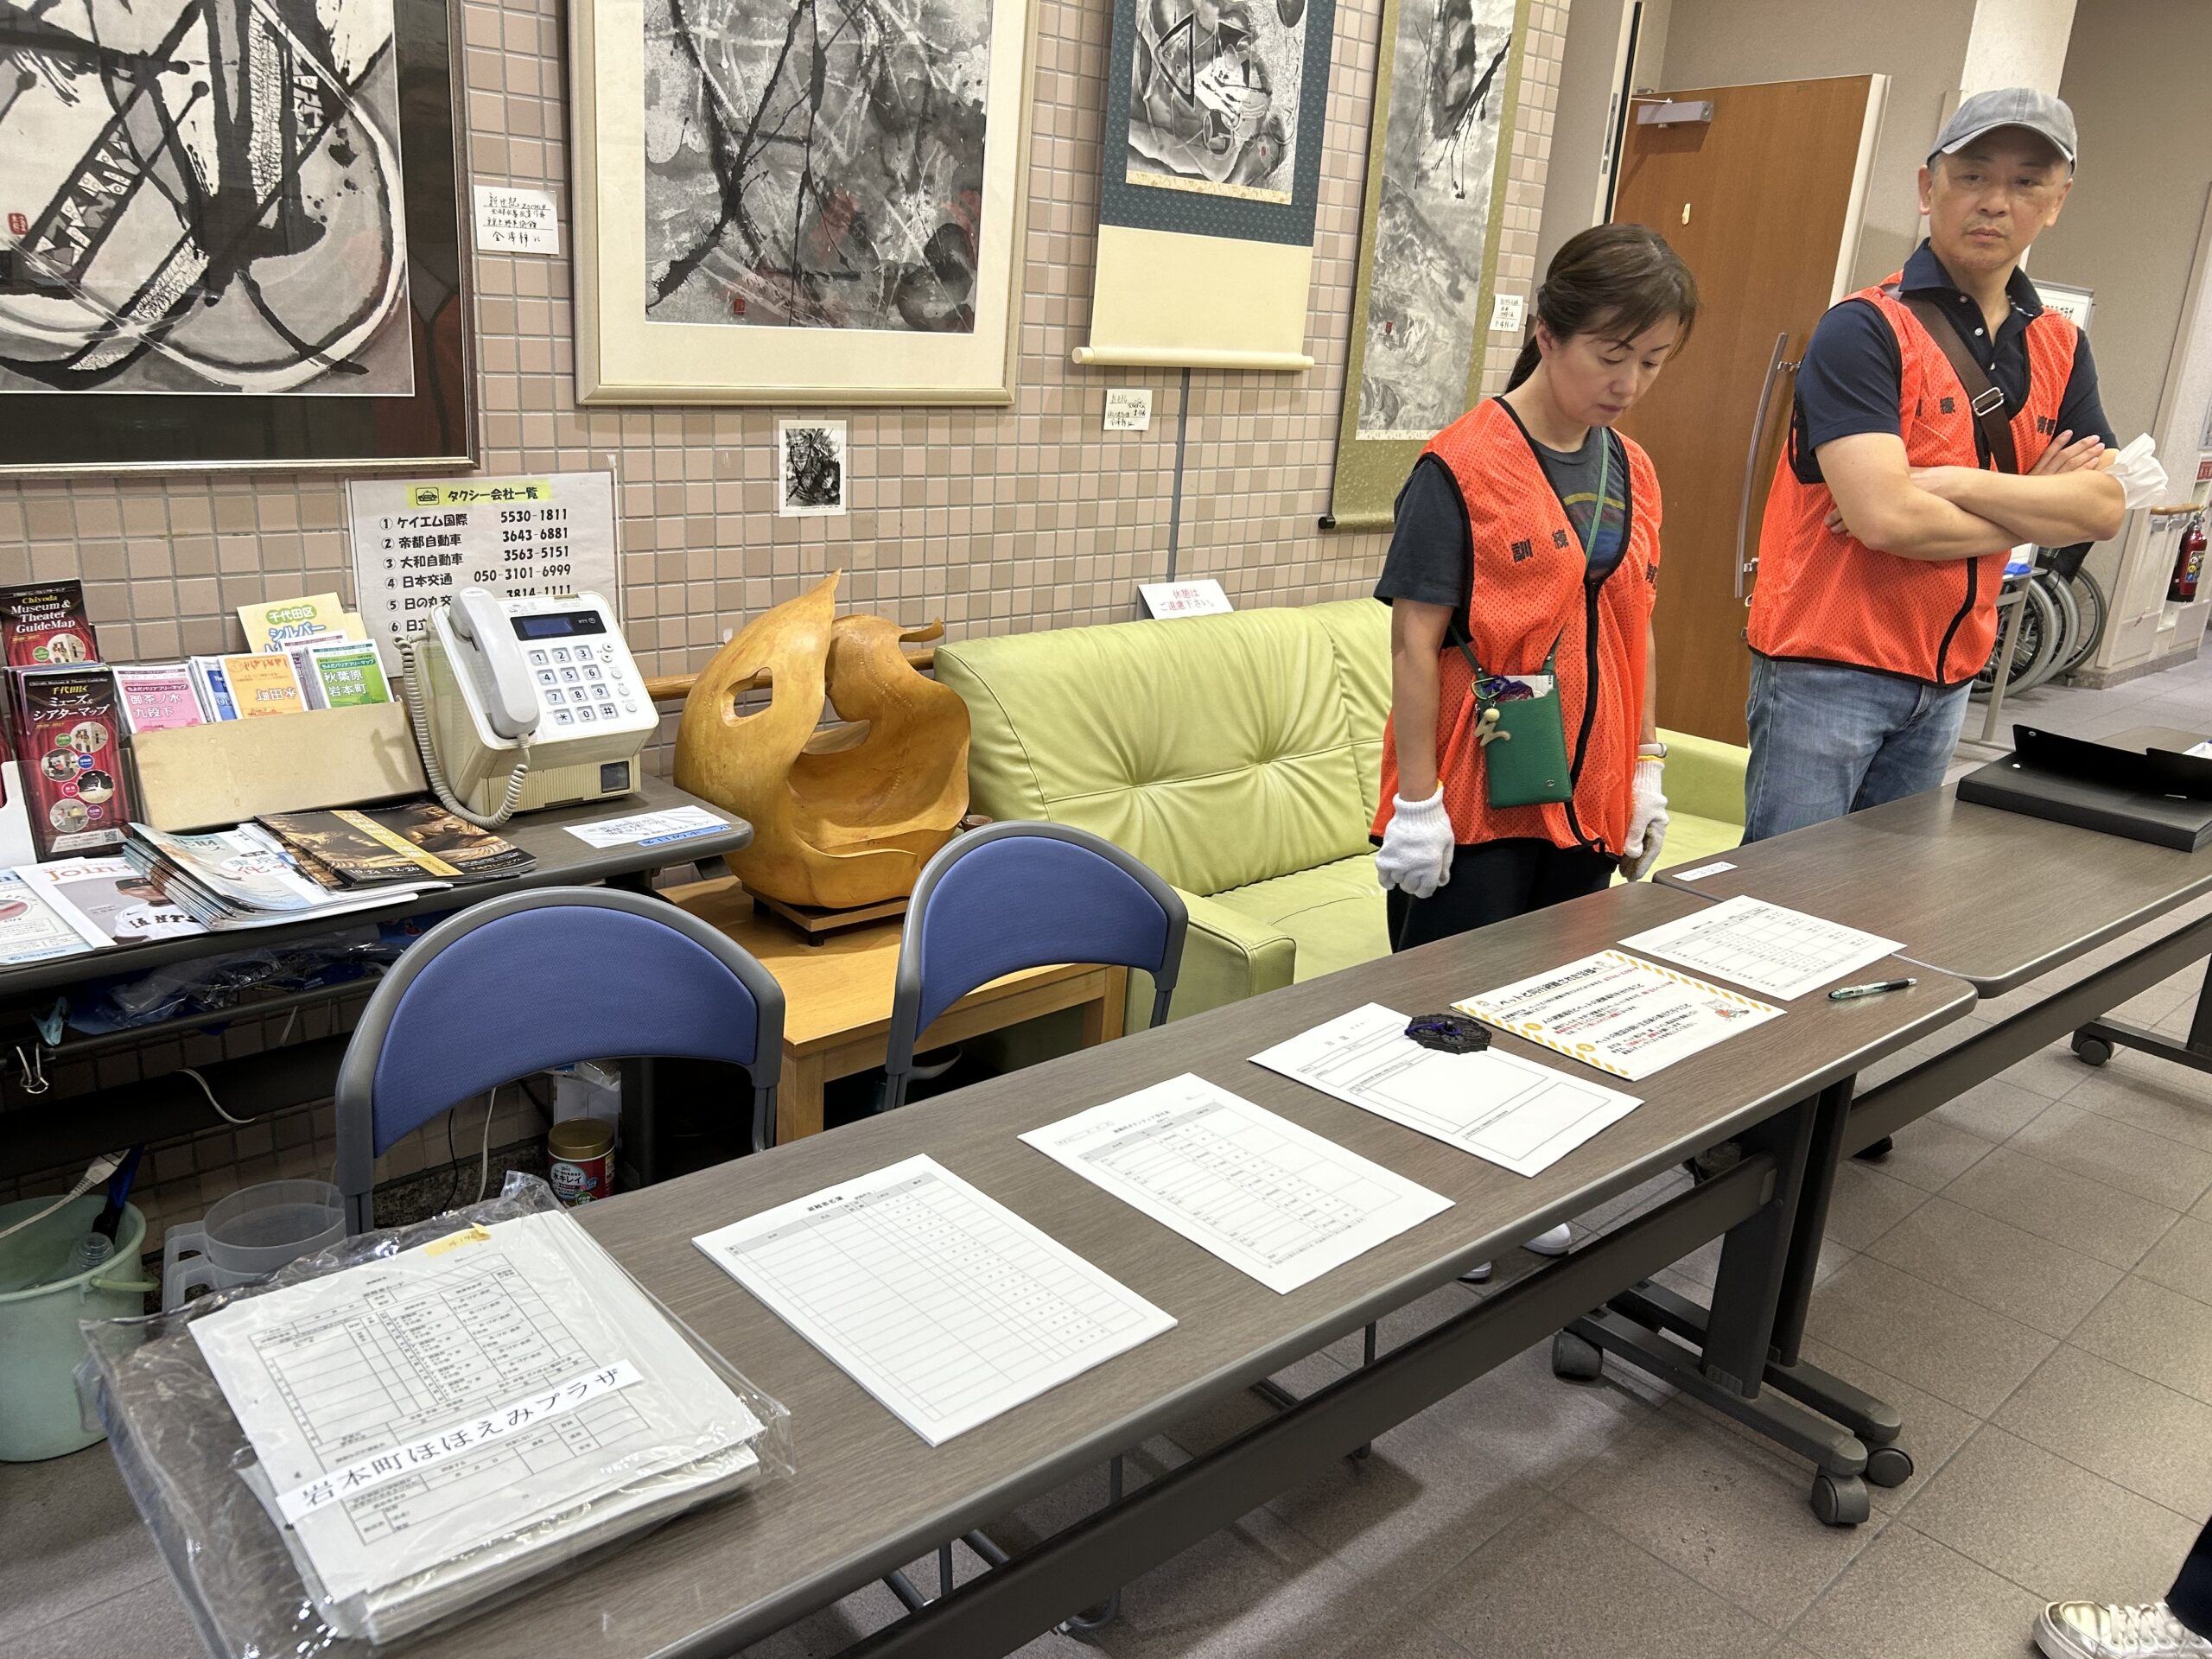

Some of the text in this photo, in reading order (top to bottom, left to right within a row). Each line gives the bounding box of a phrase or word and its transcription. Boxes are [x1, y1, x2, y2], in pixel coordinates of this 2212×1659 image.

[448, 486, 538, 502] タクシー会社一覧
[397, 513, 467, 530] ケイエム国際
[500, 508, 567, 523] 5530-1811
[399, 534, 462, 549] 帝都自動車
[502, 527, 568, 543] 3643-6881
[400, 553, 464, 569] 大和自動車
[504, 546, 569, 562] 3563-5151
[403, 573, 453, 588] 日本交通
[474, 564, 571, 582] 050-3101-6999
[10, 600, 71, 614] Museum &
[22, 595, 58, 604] Chiyoda
[20, 611, 66, 623] Theater
[269, 607, 315, 622] 千代田区
[16, 620, 75, 633] GuideMap
[270, 622, 326, 641] シルバー
[324, 669, 363, 683] 秋葉原
[329, 683, 366, 697] 岩本町
[130, 693, 181, 705] 御茶ノ水
[34, 704, 111, 721] シアターマップ
[135, 707, 173, 718] 九段下
[302, 1368, 620, 1507] 岩本町ほほえみプラザ
